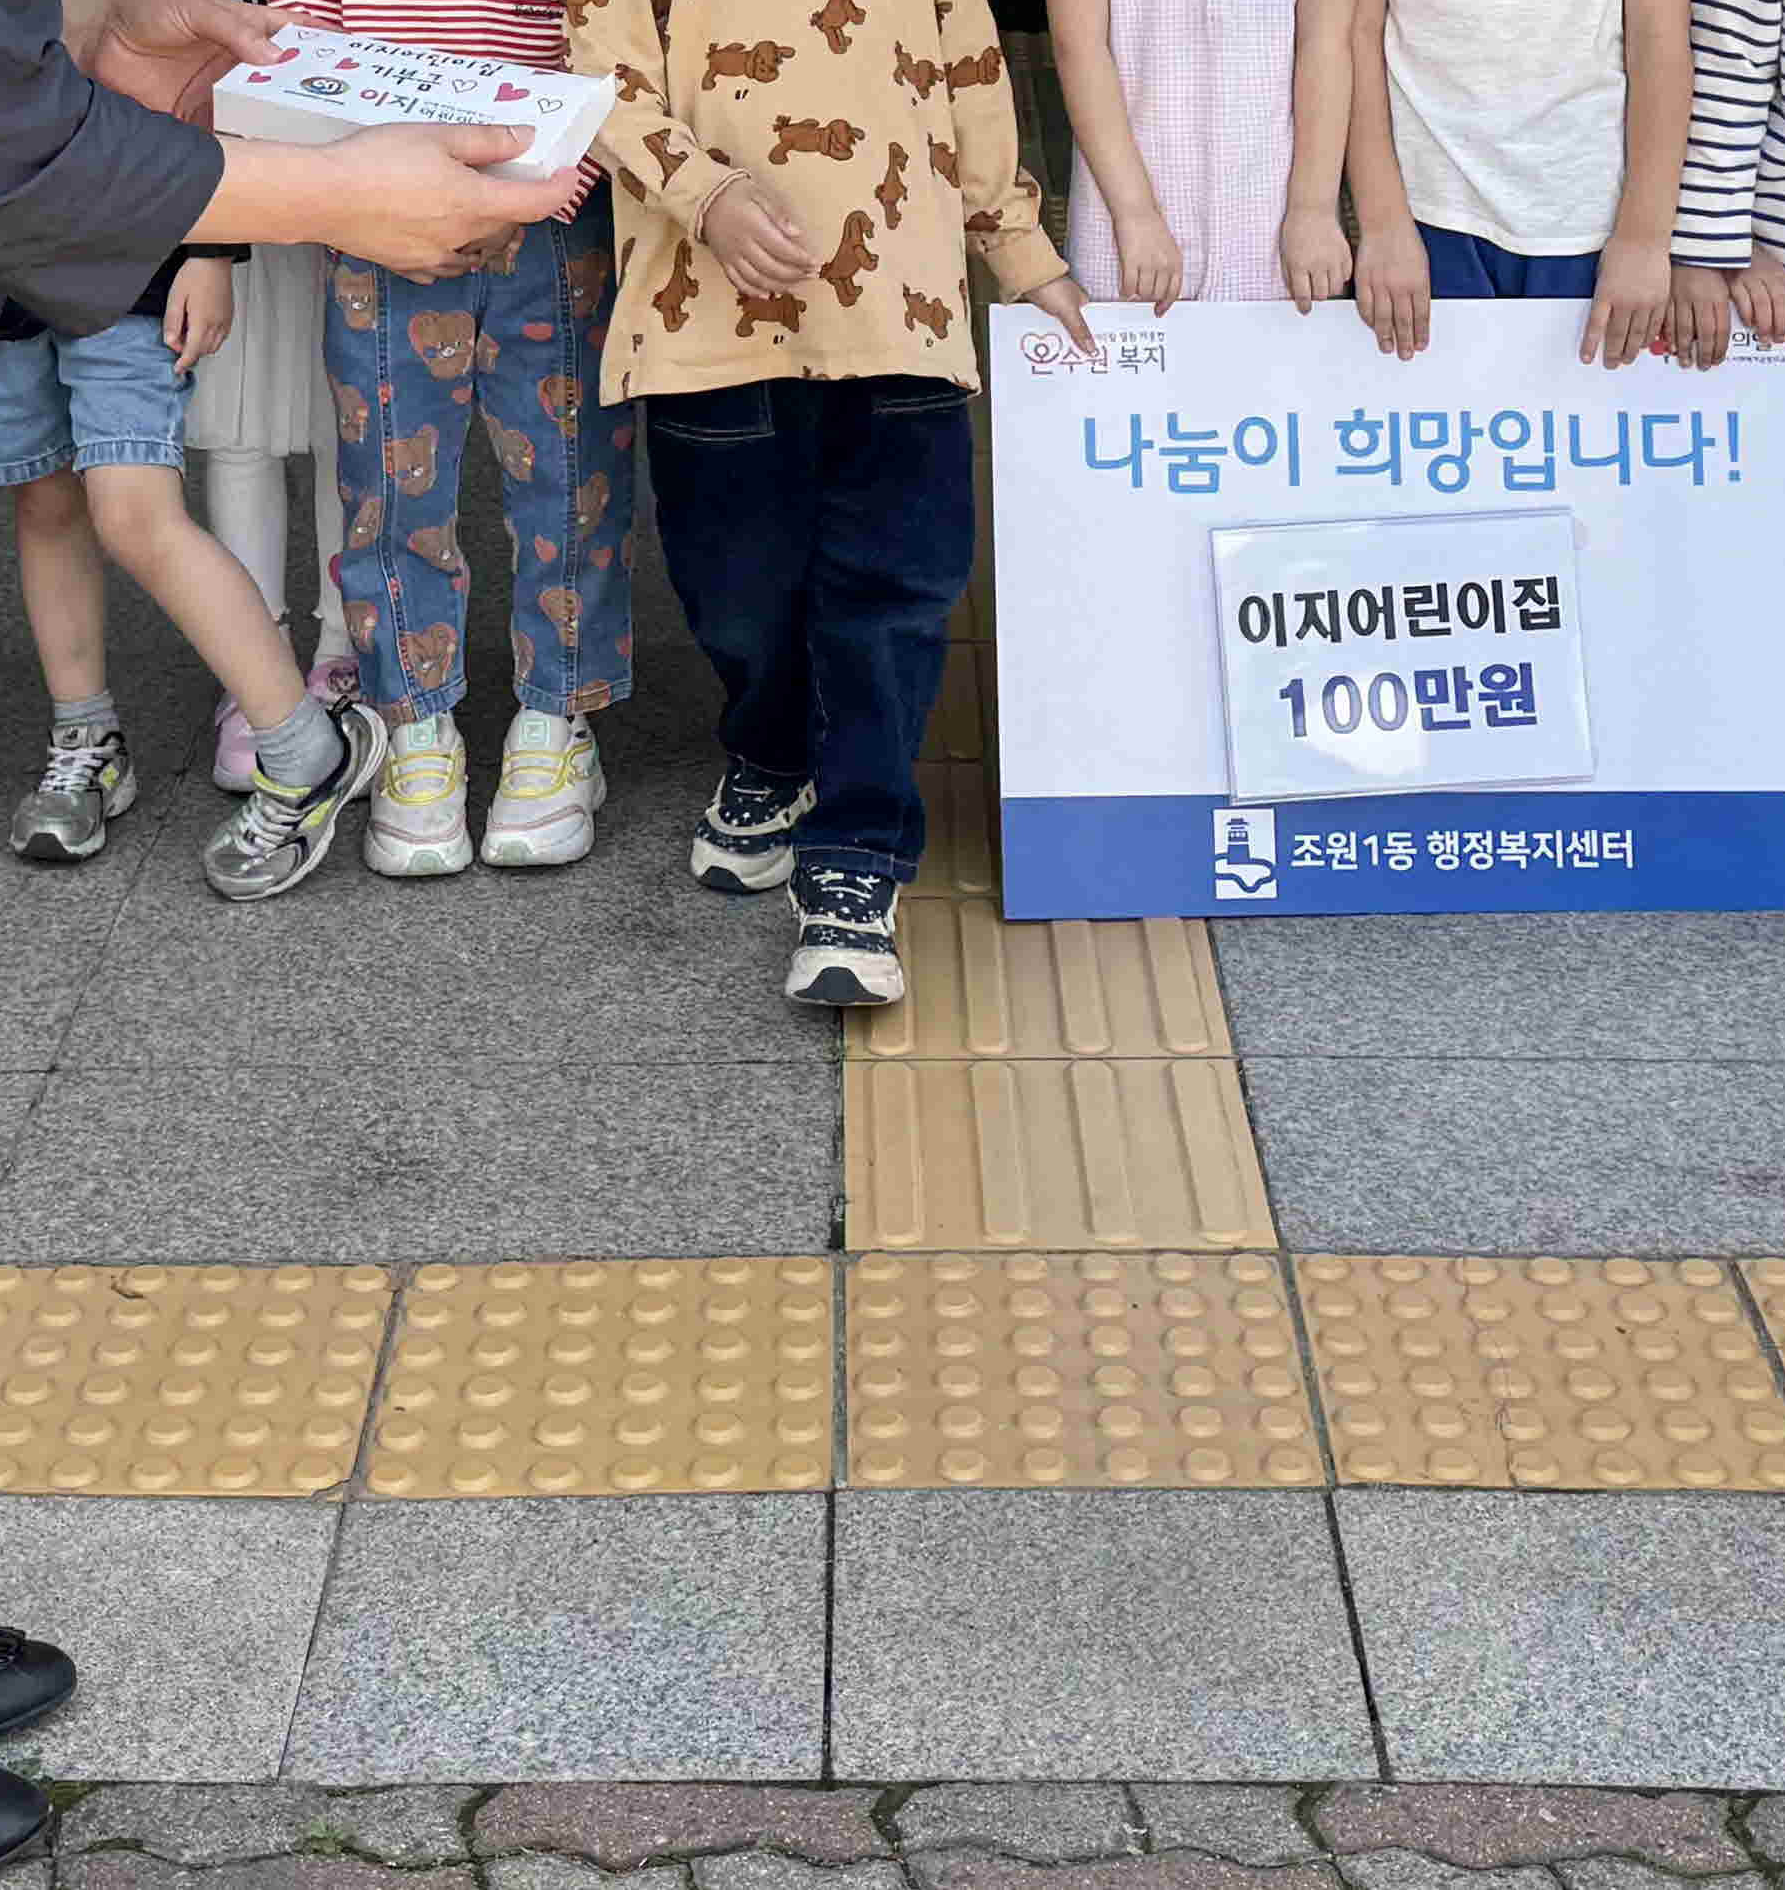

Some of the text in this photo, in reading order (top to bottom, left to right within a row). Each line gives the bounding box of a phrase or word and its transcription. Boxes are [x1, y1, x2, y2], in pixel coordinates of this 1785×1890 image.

[349, 41, 503, 78] 이지어린이집
[372, 63, 442, 92] 기부금
[360, 89, 419, 114] 이지
[1117, 345, 1167, 375] 복지
[1083, 408, 1742, 495] 나눔이 희망입니다!
[1237, 575, 1562, 648] 이지어린이집
[1278, 661, 1539, 739] 100만원
[1290, 829, 1635, 872] 조원1동 행정복지센터
